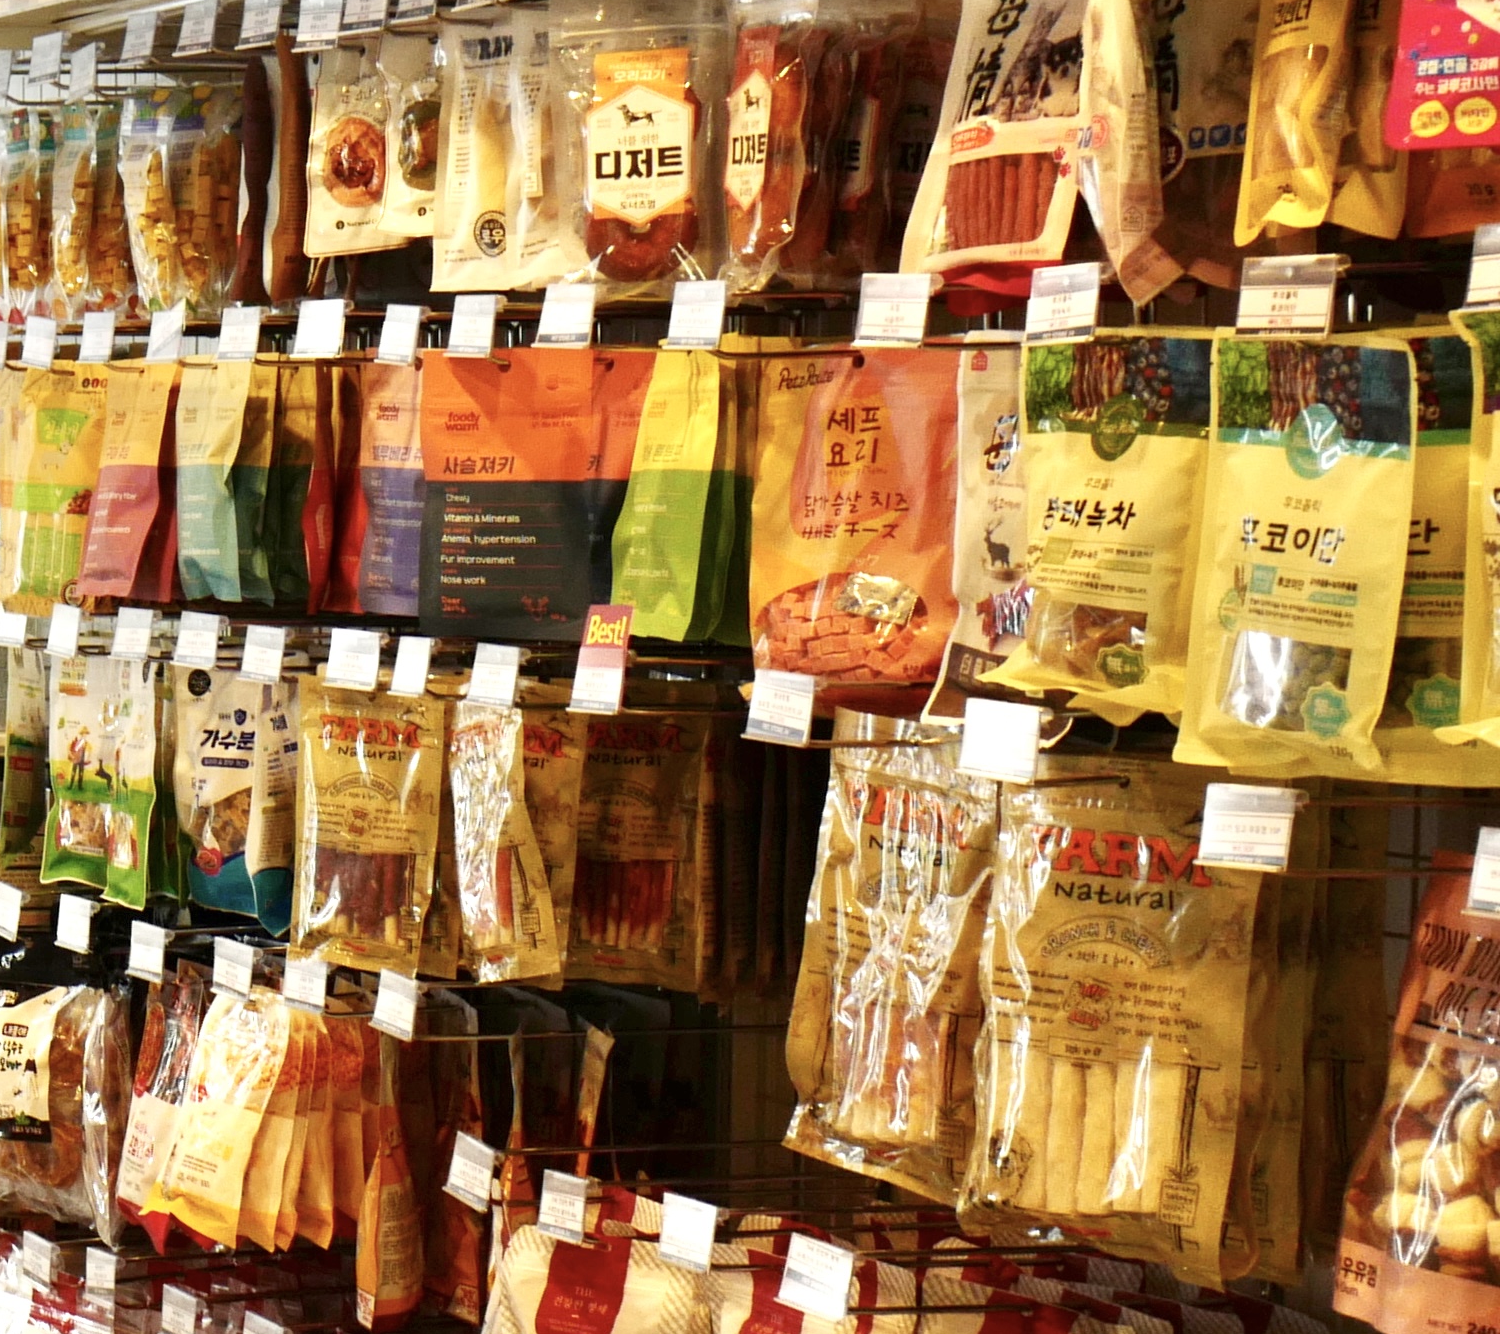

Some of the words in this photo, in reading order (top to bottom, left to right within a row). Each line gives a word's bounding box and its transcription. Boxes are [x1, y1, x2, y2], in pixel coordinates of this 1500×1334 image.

[613, 67, 666, 81] 오리고기
[595, 145, 685, 180] 디저트
[448, 411, 480, 426] foody
[827, 406, 882, 433] 셰프
[443, 456, 515, 475] 사슴져키
[826, 438, 879, 468] 요리
[1240, 515, 1344, 566] 후코이단
[587, 615, 625, 648] Best!
[318, 715, 420, 750] FARM
[338, 746, 402, 762] Natural
[1030, 826, 1214, 887] FARM
[1054, 881, 1175, 911] Natural
